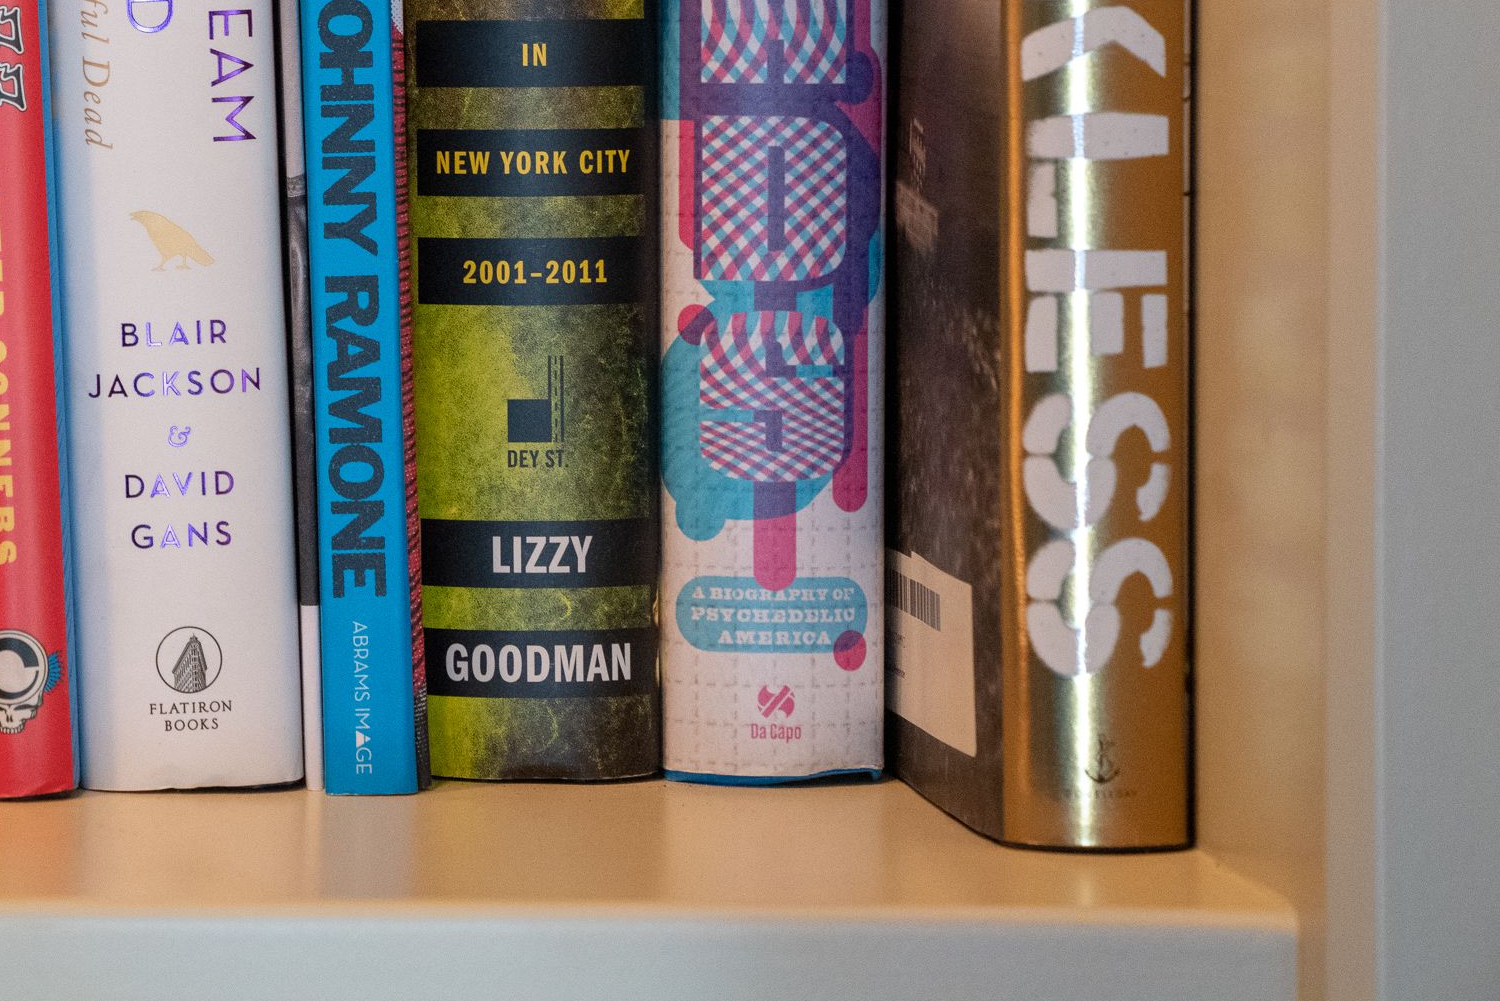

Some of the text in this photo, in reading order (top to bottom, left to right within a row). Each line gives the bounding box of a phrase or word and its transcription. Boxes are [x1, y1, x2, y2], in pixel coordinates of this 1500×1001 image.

[521, 43, 547, 67] IN
[82, 56, 113, 149] Dead
[436, 149, 631, 175] NEW YORK CITY
[120, 319, 227, 347] BLAIR
[88, 367, 261, 398] JACKSON
[167, 425, 191, 448] &
[324, 275, 387, 599] RAMONE
[507, 449, 569, 468] DEY ST.
[124, 471, 234, 499] DAVID
[131, 521, 232, 549] GANS
[492, 535, 594, 574] LIZZY
[692, 586, 855, 601] A BIOGRAPHY OF
[691, 607, 855, 623] PSYCHEDELIC
[718, 631, 831, 645] AMERICA
[445, 643, 632, 682] GOODMAN
[149, 700, 232, 715] FLATIRON
[352, 620, 372, 775] ABRAMS IMAGE
[164, 718, 219, 732] BOOKS
[750, 724, 802, 743] Da Capo
